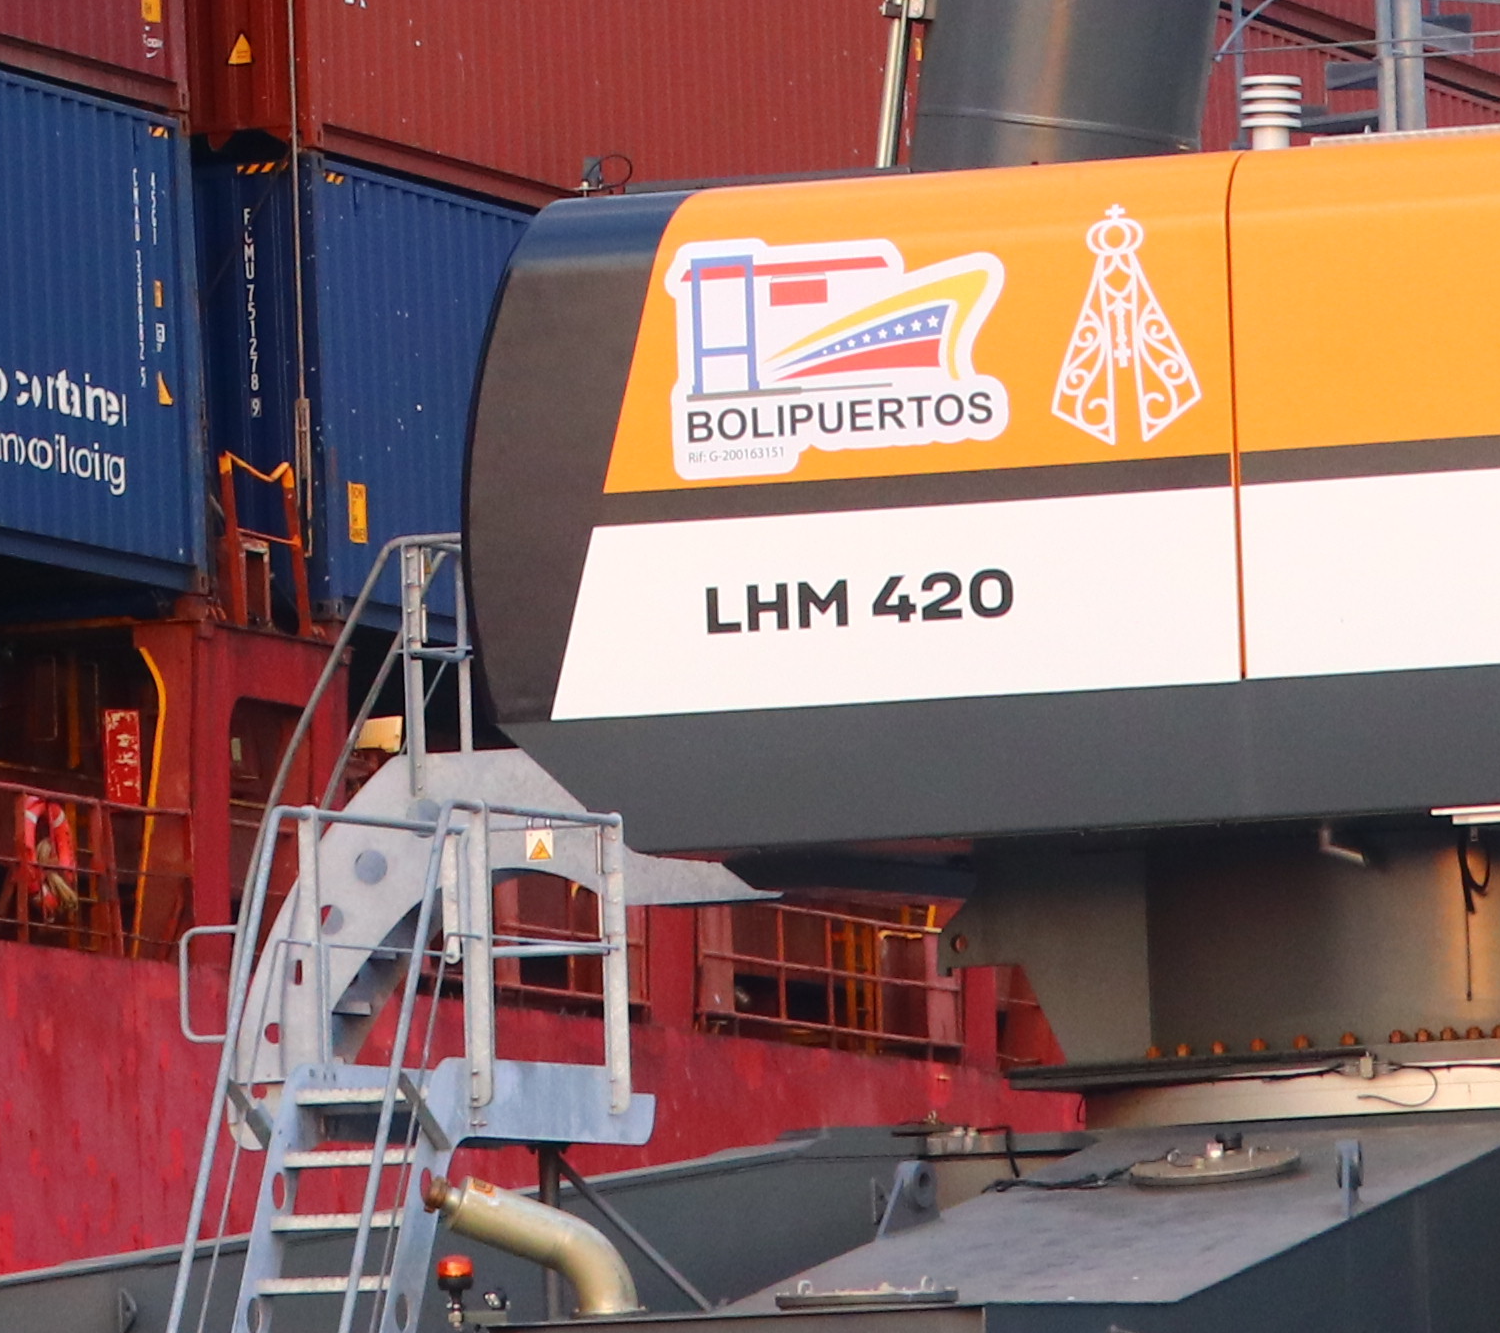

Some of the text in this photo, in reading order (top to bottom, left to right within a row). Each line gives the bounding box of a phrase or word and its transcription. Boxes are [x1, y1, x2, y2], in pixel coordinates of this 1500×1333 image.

[246, 284, 260, 392] 751278
[14, 368, 127, 427] cotaine
[686, 391, 994, 444] BOLIPUERTOS
[688, 446, 785, 464] Rif: G-200163151
[704, 568, 1015, 635] LHM 420
